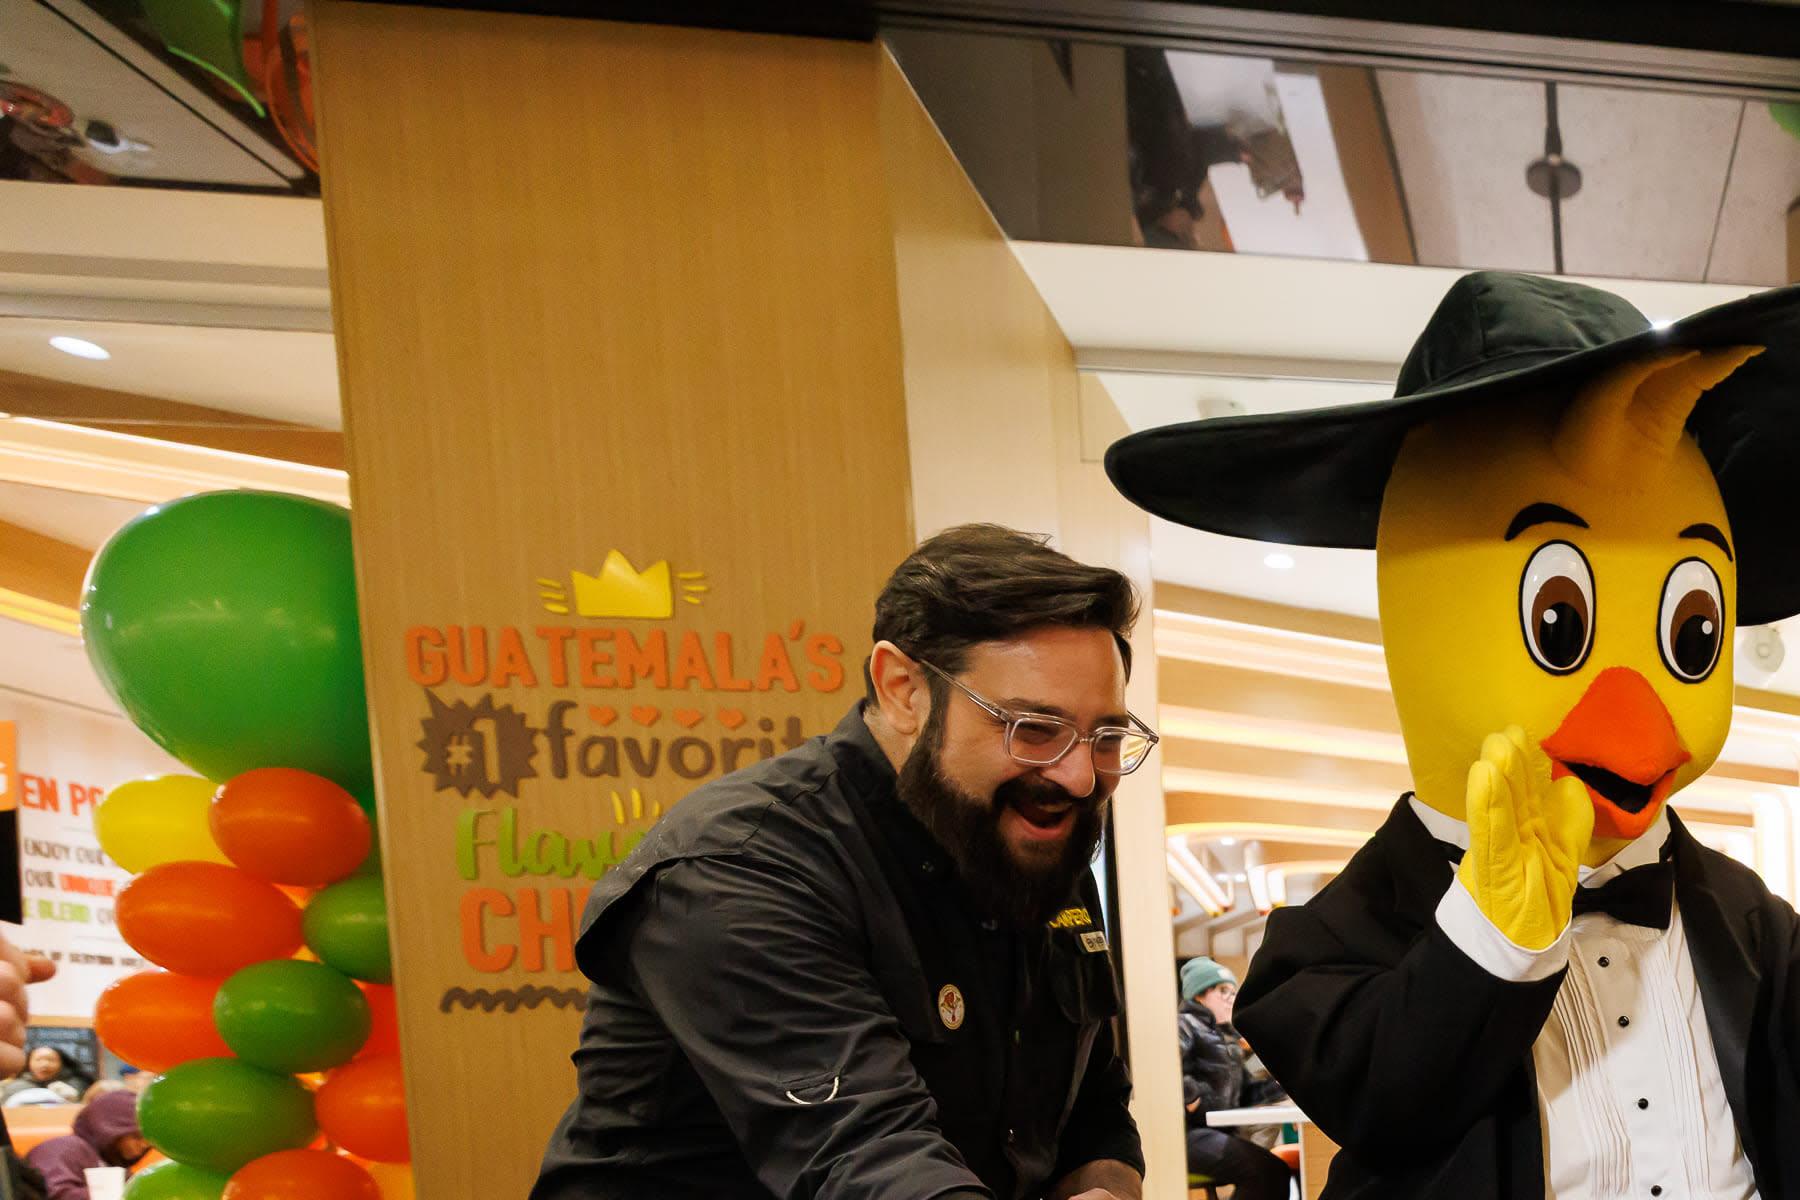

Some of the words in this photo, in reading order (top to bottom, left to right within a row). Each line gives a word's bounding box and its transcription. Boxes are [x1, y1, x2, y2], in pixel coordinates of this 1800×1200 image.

[404, 620, 845, 693] GUATEMALA'S
[445, 718, 501, 784] #1
[459, 887, 592, 973] CH
